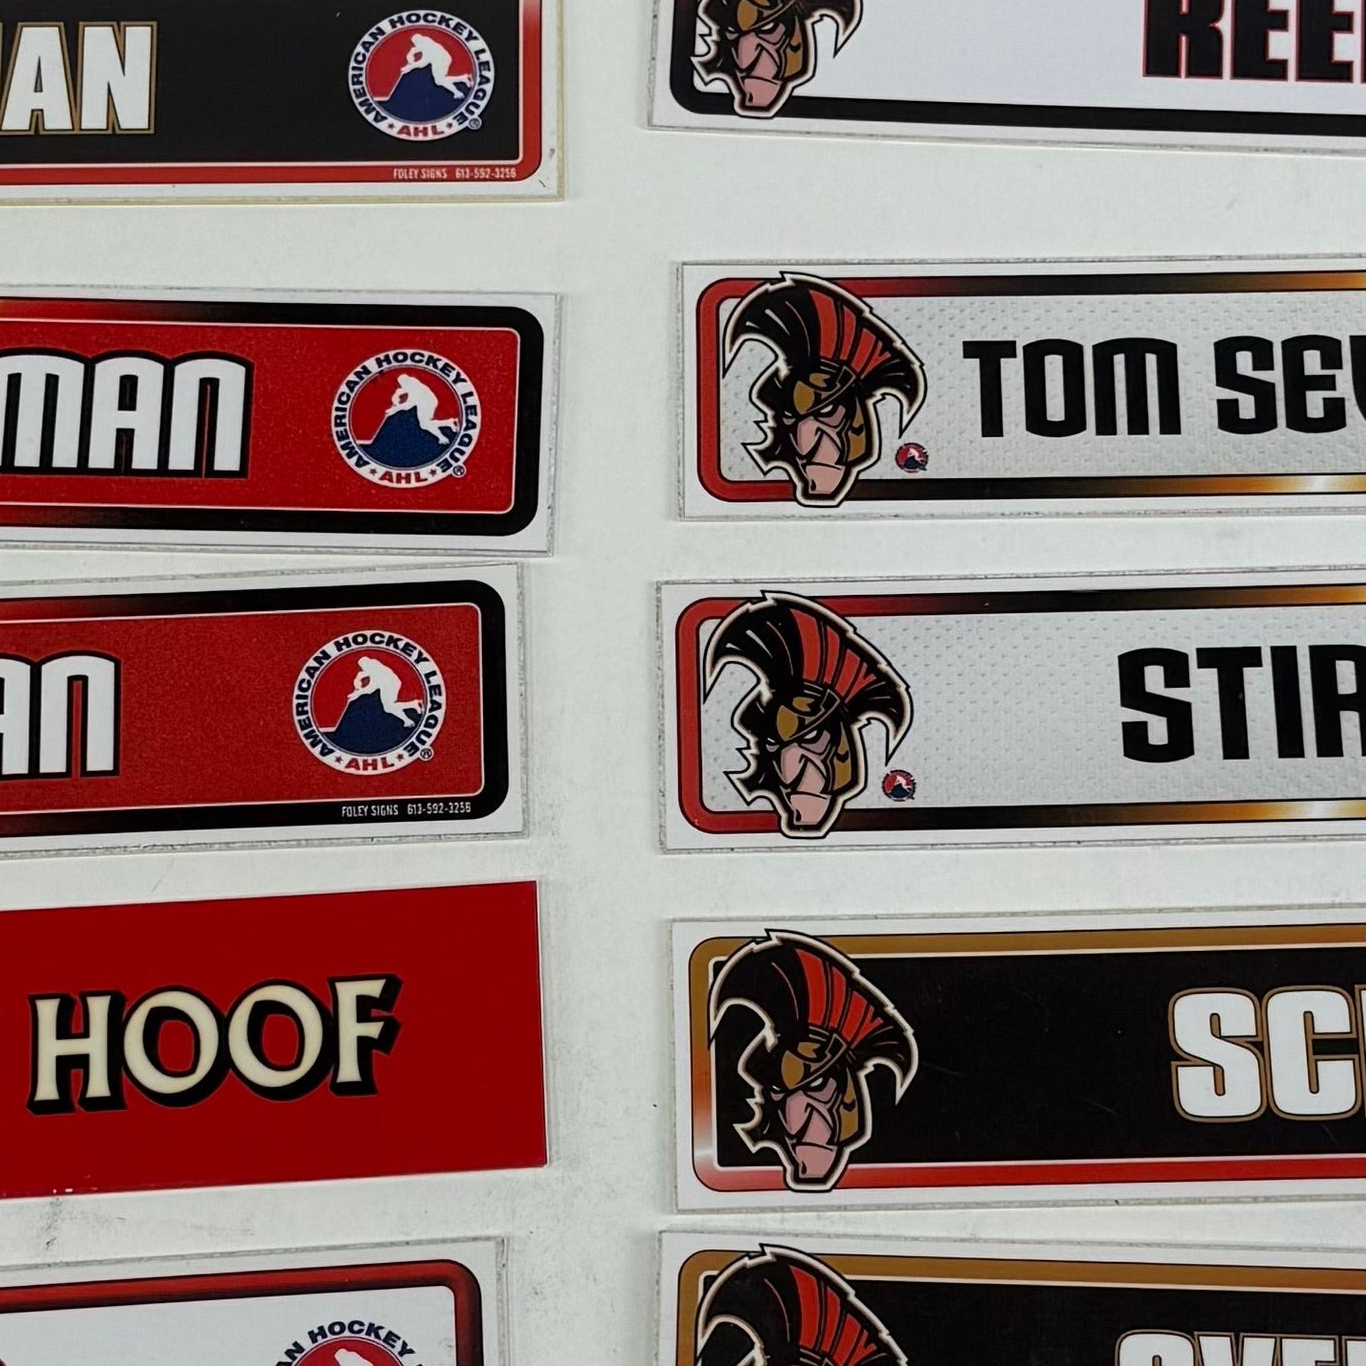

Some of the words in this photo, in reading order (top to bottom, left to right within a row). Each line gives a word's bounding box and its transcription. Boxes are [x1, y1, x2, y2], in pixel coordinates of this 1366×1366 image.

[351, 26, 388, 124] AMERICAN
[389, 13, 479, 44] HOCKEY
[453, 48, 491, 126] LEAGUE
[397, 124, 445, 137] AHL
[393, 169, 419, 179] FOLEY
[421, 168, 448, 179] SIGNS
[963, 337, 1182, 439] TOM
[334, 366, 371, 469] AMERICAN
[375, 352, 468, 386] HOCKEY
[438, 390, 478, 473] LEAGUE
[379, 471, 428, 484] AHL
[296, 649, 334, 758] AMERICAN
[334, 633, 429, 667] HOCKEY
[403, 670, 443, 757] LEAGUE
[345, 758, 395, 771] AHL
[342, 806, 368, 817] FOLEY
[371, 805, 399, 816] SIGNS
[28, 974, 403, 1115] HOOF
[308, 1320, 415, 1357] HOCKEY
